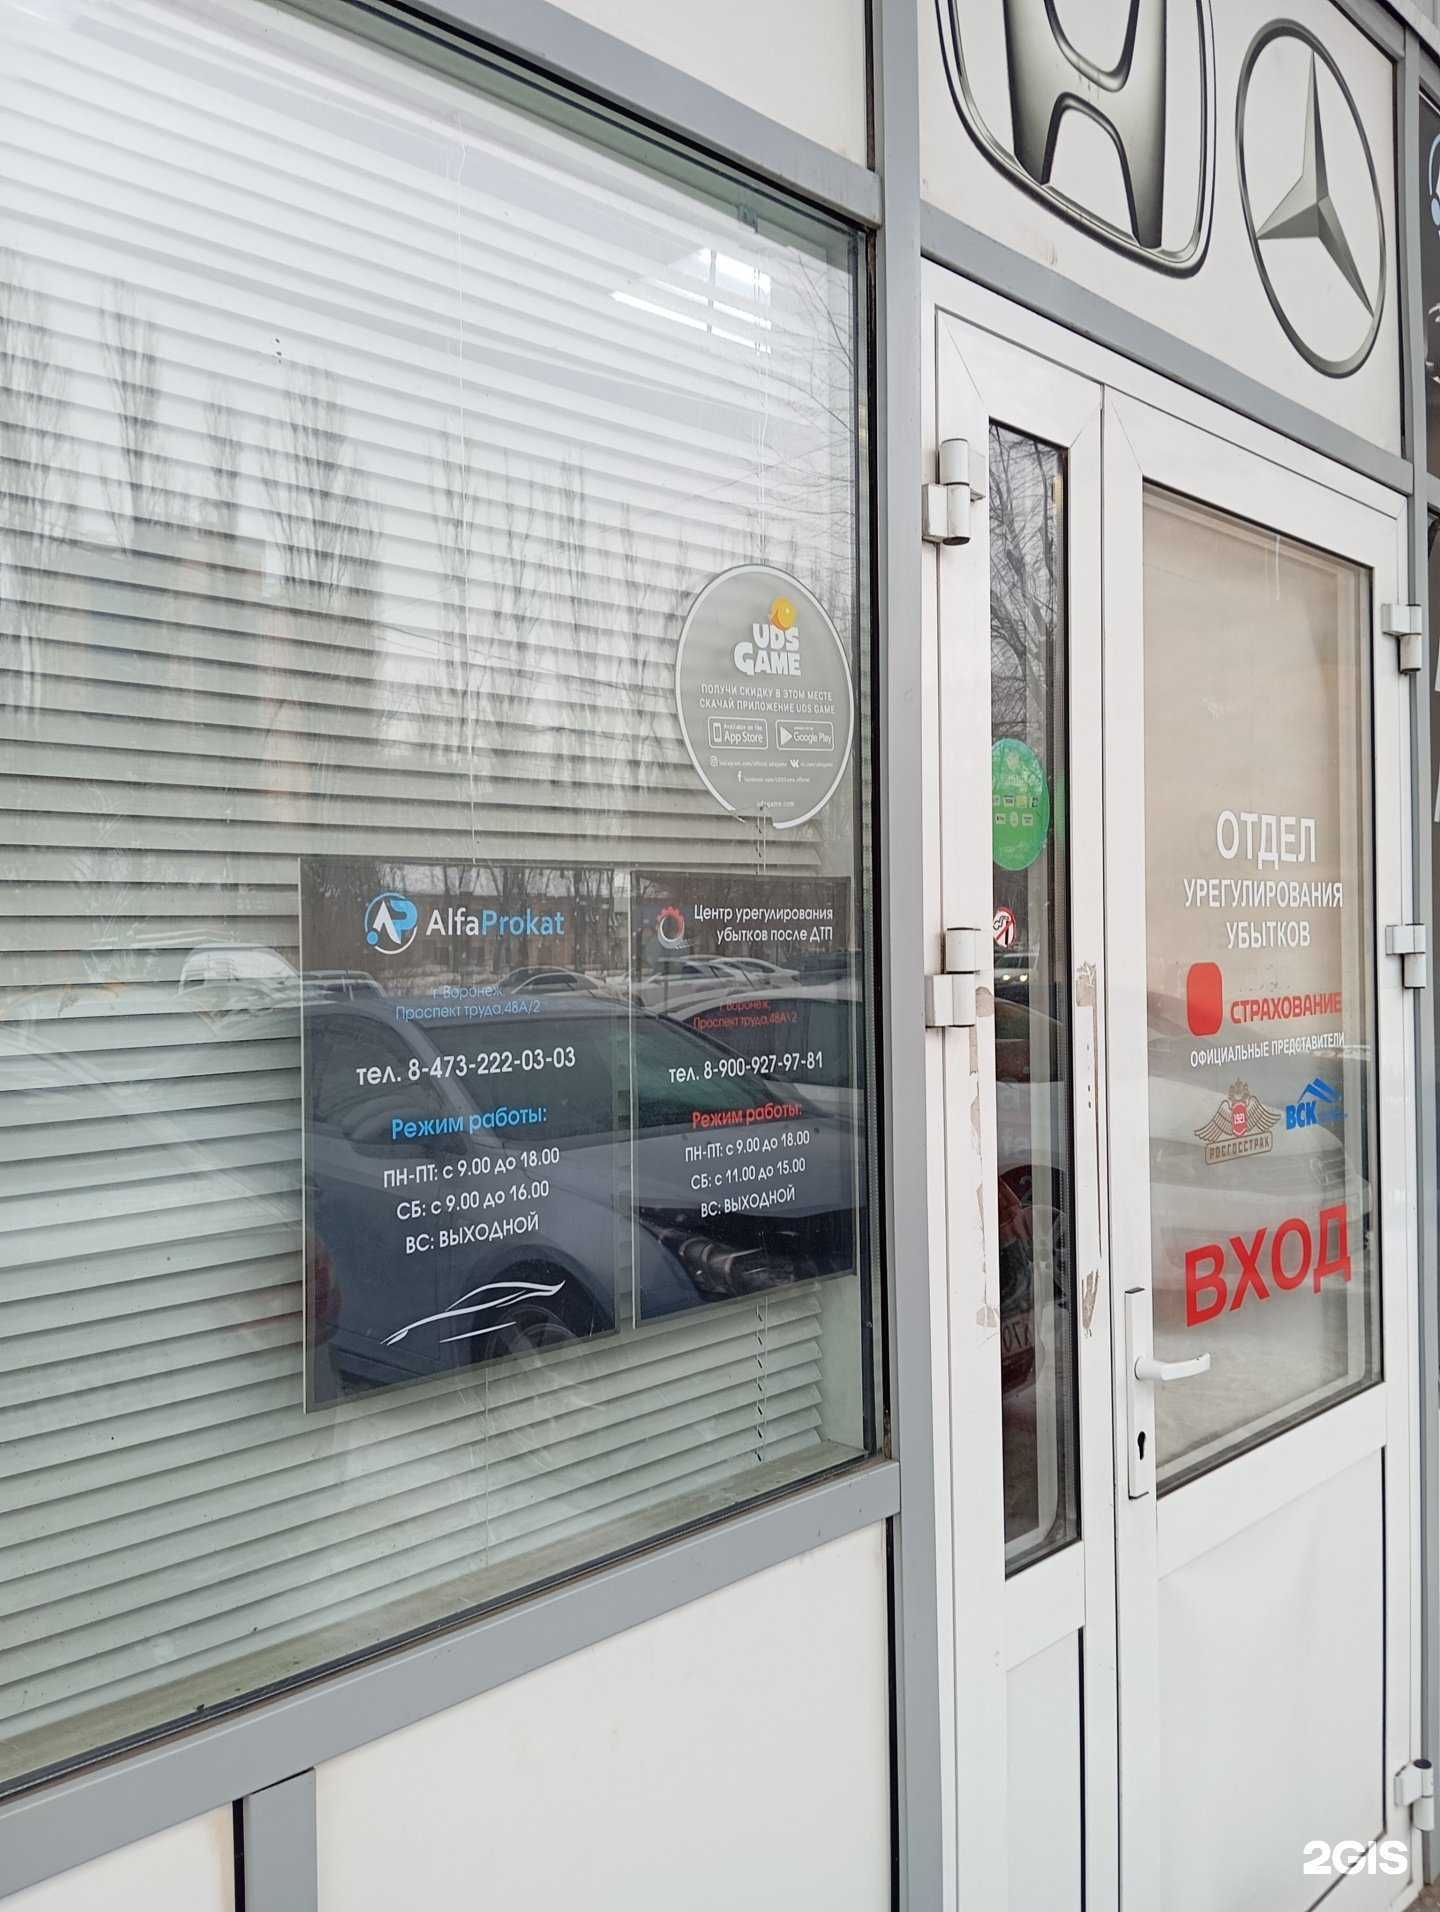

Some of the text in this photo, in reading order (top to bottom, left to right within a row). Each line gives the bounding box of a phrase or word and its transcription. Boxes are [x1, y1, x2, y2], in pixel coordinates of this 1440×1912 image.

[753, 623, 800, 650] UDS
[734, 642, 801, 675] GAME
[699, 697, 836, 714] СКАЧАЙ ПРИЛОЖЕНИЕ UDS GAME
[701, 683, 833, 701] ПОЛУЧИ СКИДКУ В ЭТОМ МЕСТЕ
[724, 731, 763, 745] App Store
[793, 732, 832, 745] Google Play
[1215, 810, 1317, 870] ОТДЕЛ
[1183, 878, 1344, 908] УРЕГУЛИРОВАНИЯ
[426, 907, 565, 936] AlfaProkat
[694, 904, 833, 923] Центр урегулирования
[717, 926, 833, 944] убытков после ДТП
[1226, 920, 1311, 949] УБЫТКОВ
[396, 1005, 461, 1023] Проспект
[1230, 991, 1342, 1024] СТРАХОВАНИЕ
[693, 1015, 738, 1032] Проспект
[1190, 1031, 1345, 1068] ОФИЦИАЛЬНЫЕ ПРЕДСТАВИТЕЛИ
[356, 1046, 577, 1085] тел. 8-473-222-03-03
[669, 1051, 823, 1083] тел. 8-900-927-97-81
[392, 1107, 548, 1140] Режим работы:
[692, 1102, 803, 1129] Режим работы:
[1286, 1101, 1317, 1130] ВСК
[685, 1130, 810, 1162] ПН-ПТ: с 9.00 до 18.00
[1209, 1135, 1270, 1160] РОСГОССТРАХ
[383, 1147, 560, 1188] ПН-ПТ: с 9.00 до 18.00
[691, 1157, 806, 1190] СБ: с 11.00 до 15.00
[397, 1180, 550, 1220] СБ: с 9.00 до 16.00
[701, 1184, 795, 1218] ВС: ВЫХОДНОЙ
[406, 1211, 539, 1254] ВС: ВЫХОДНОЙ
[1185, 1205, 1351, 1328] ВХОД
